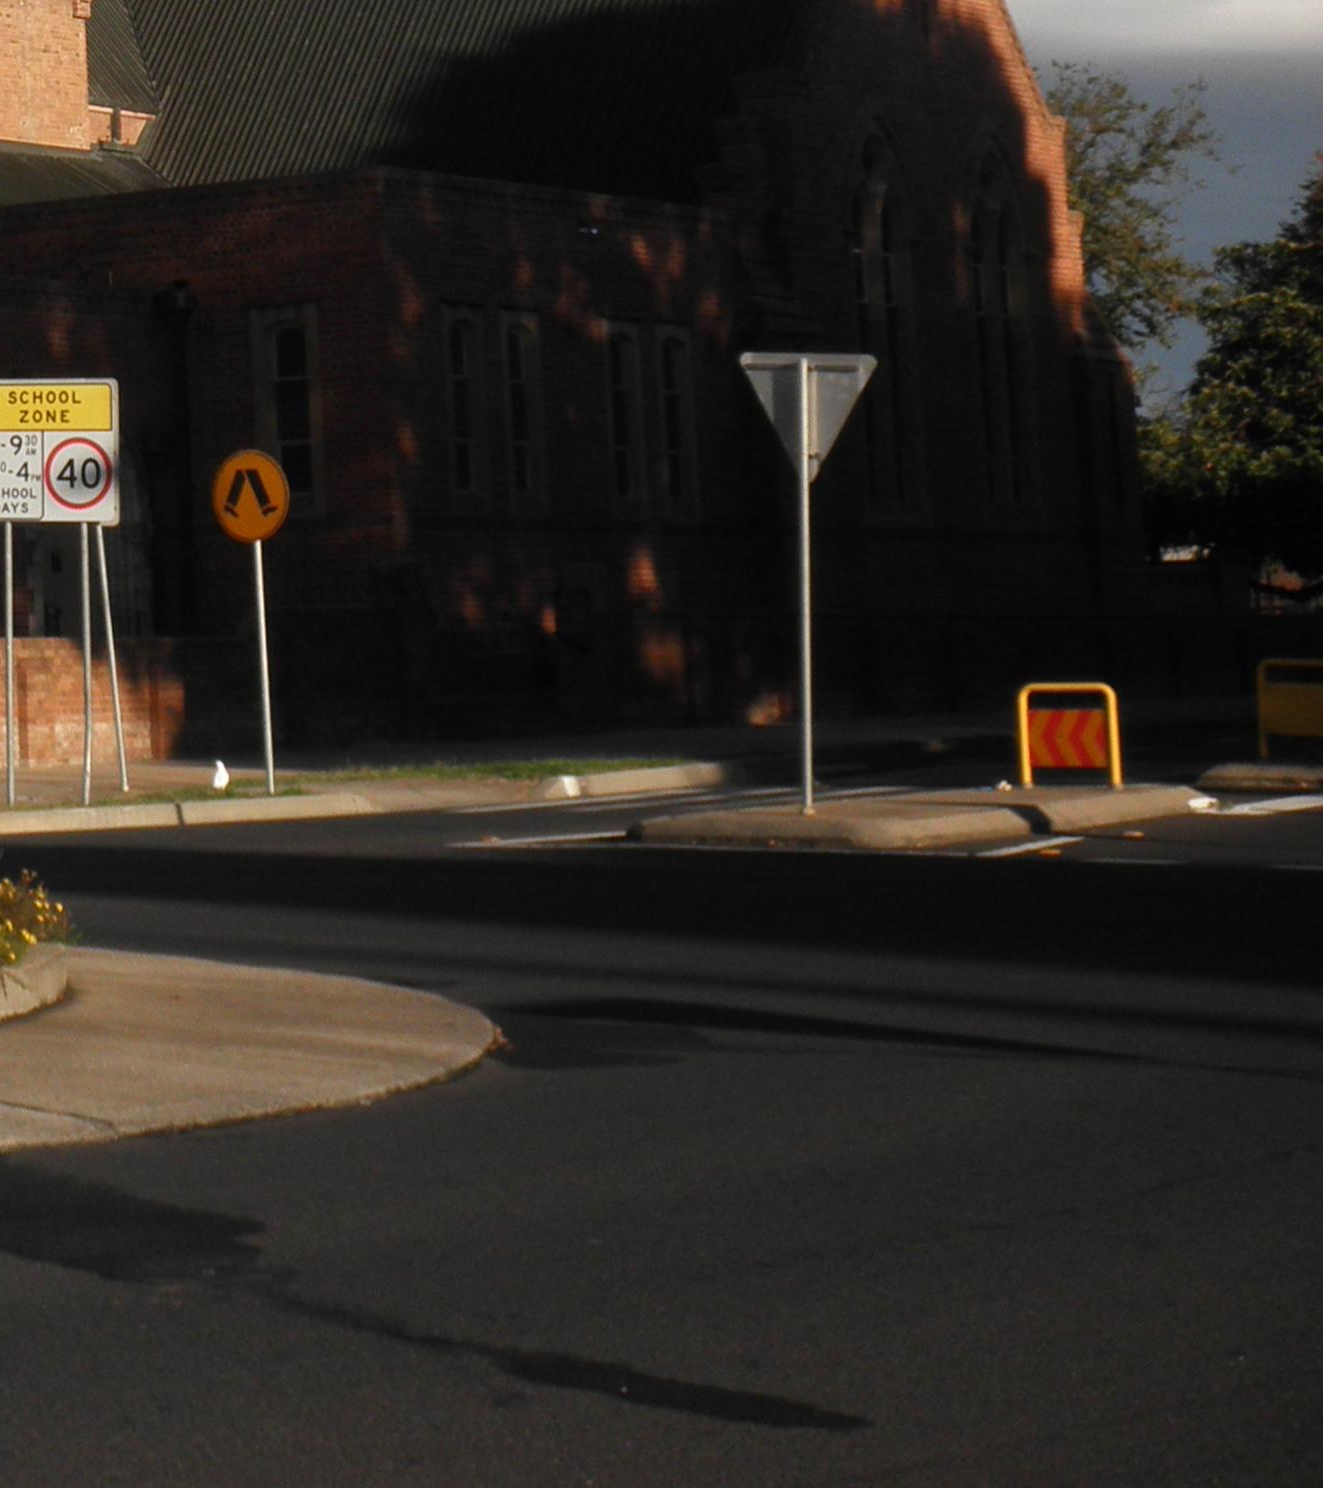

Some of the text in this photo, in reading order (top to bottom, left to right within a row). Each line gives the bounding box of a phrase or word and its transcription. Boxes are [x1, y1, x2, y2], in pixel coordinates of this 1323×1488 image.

[8, 391, 82, 405] SCHOOL
[19, 410, 71, 423] ZONE
[57, 458, 101, 489] 40
